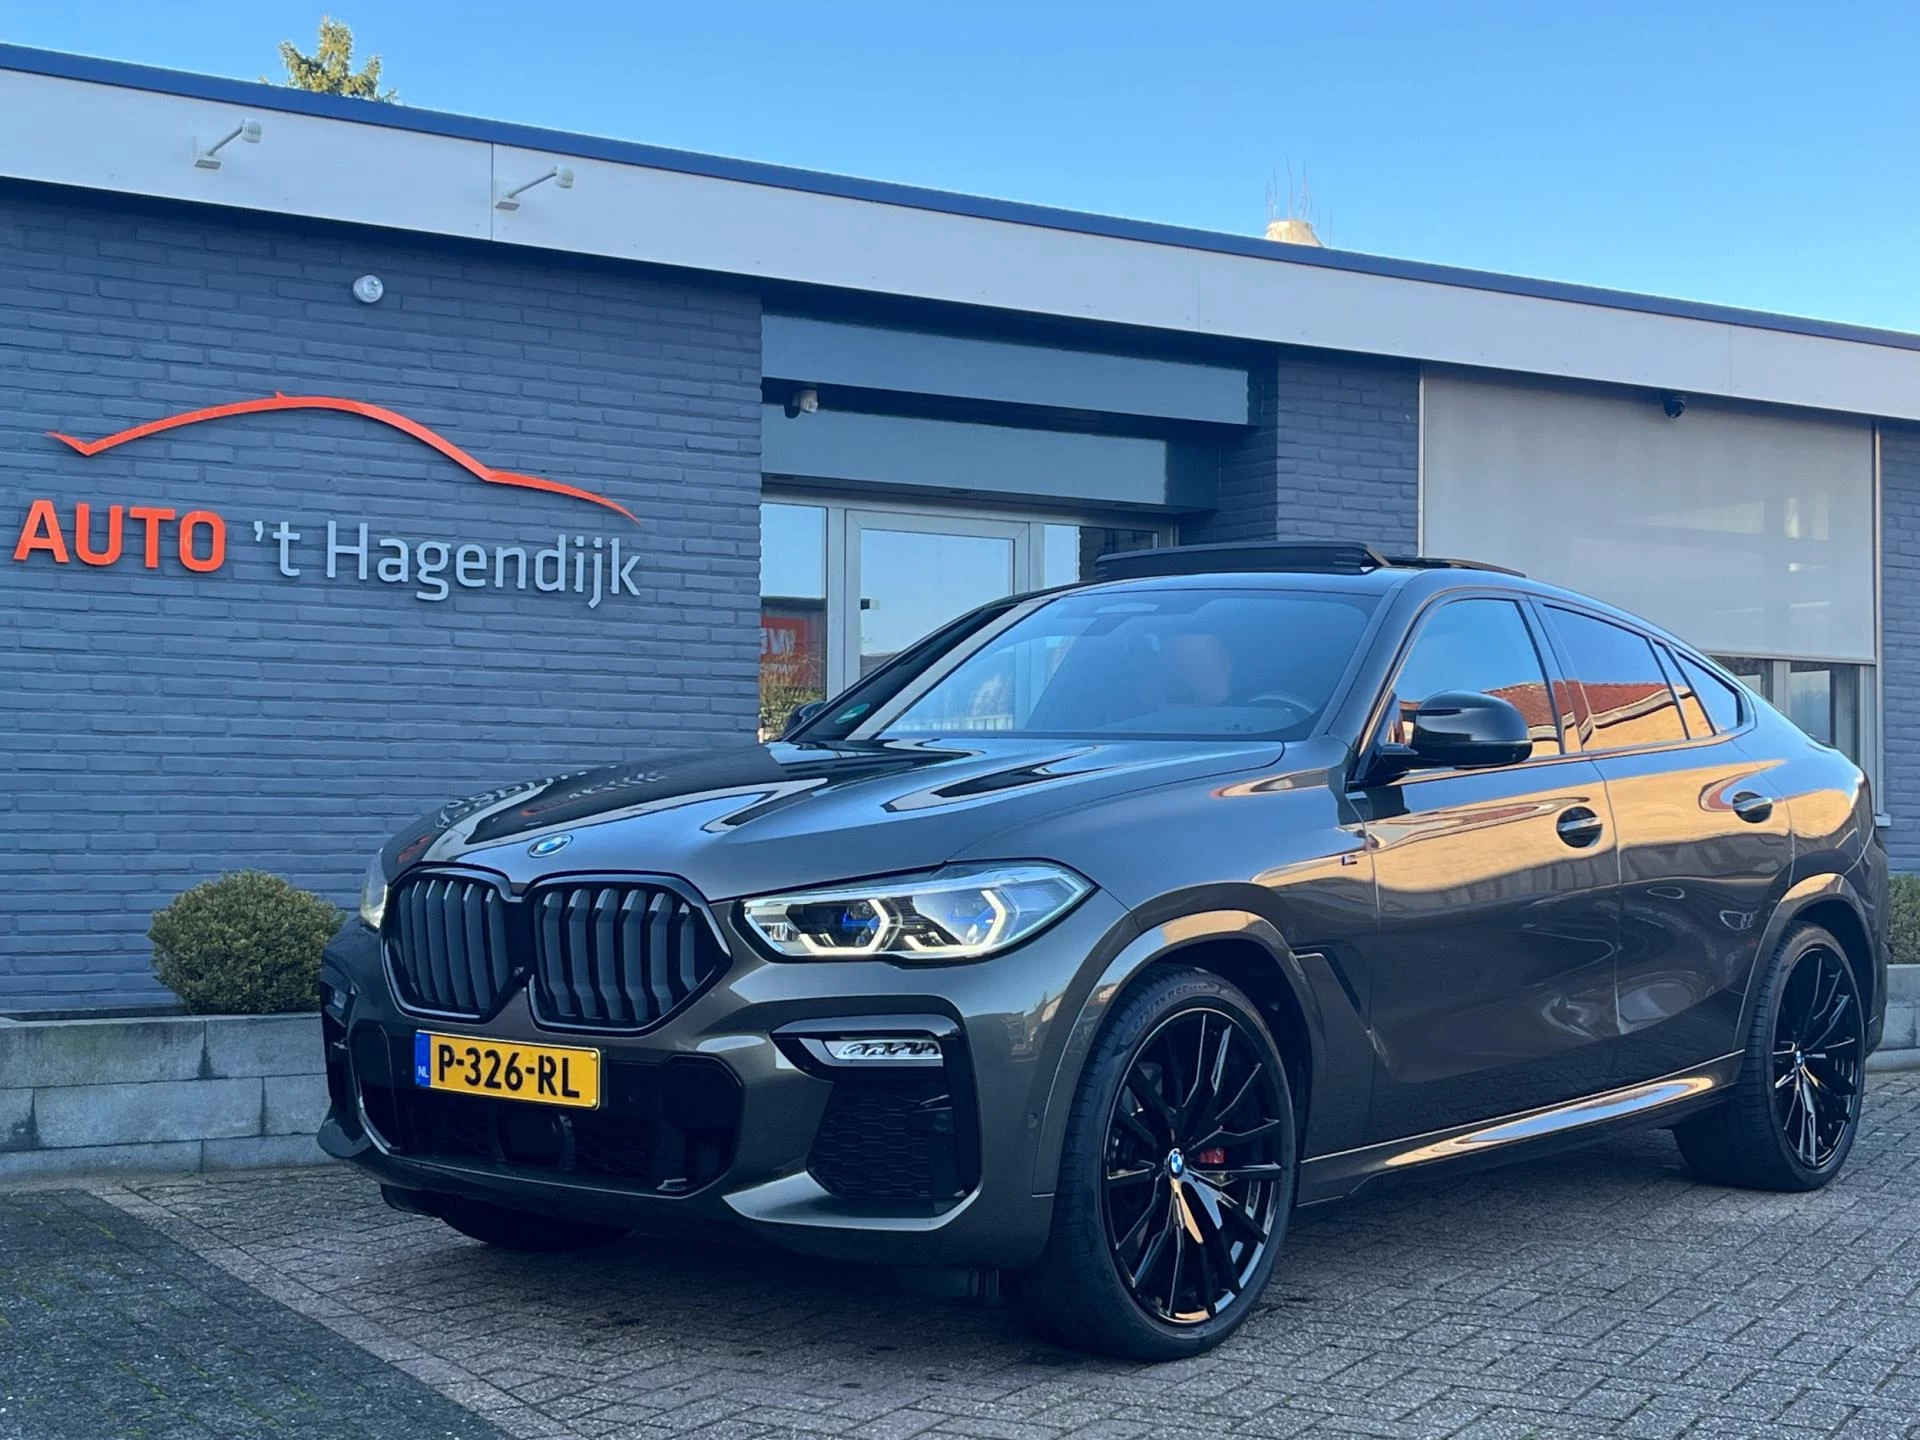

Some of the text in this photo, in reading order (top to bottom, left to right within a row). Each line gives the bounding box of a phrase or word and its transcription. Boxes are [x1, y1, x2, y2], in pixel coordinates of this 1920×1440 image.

[13, 499, 226, 572] AUTO
[325, 519, 641, 608] Hagendijk
[417, 1065, 429, 1078] NL
[438, 1043, 580, 1098] P-326-RL
